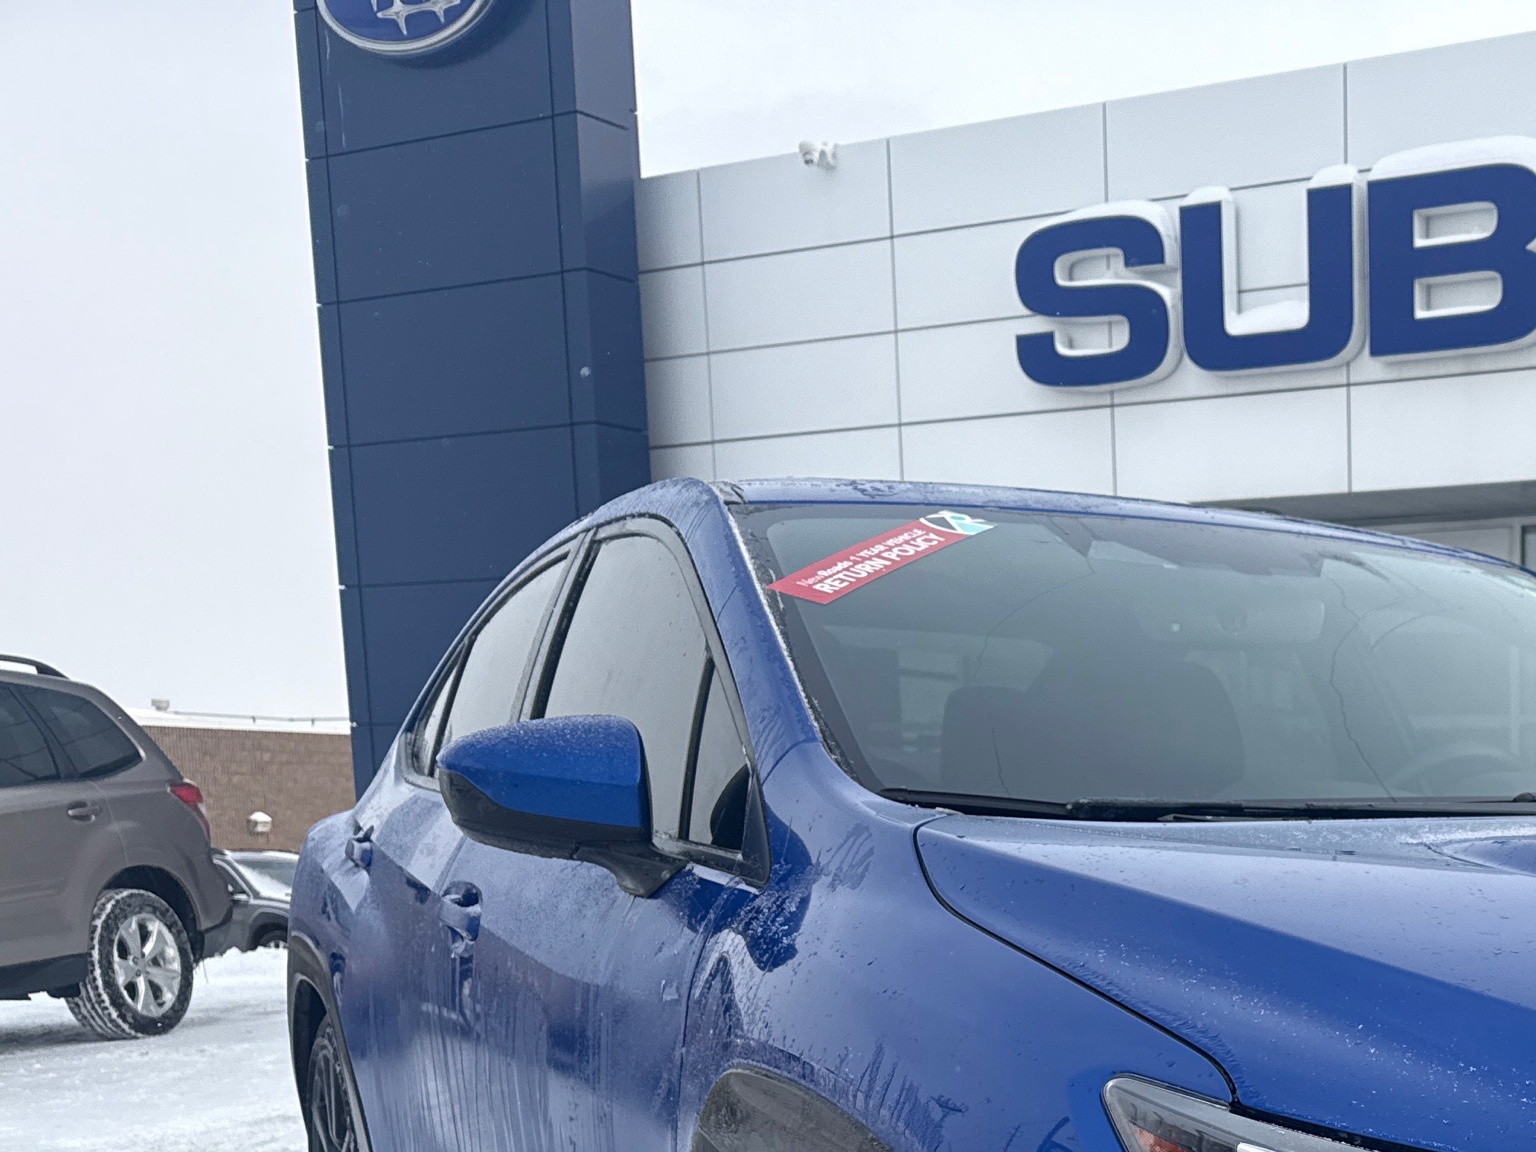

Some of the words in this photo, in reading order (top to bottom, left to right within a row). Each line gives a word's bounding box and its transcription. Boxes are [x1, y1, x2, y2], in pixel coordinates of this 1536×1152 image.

[812, 557, 892, 594] RETURN
[880, 532, 946, 562] POLICY
[855, 543, 890, 559] YEAR
